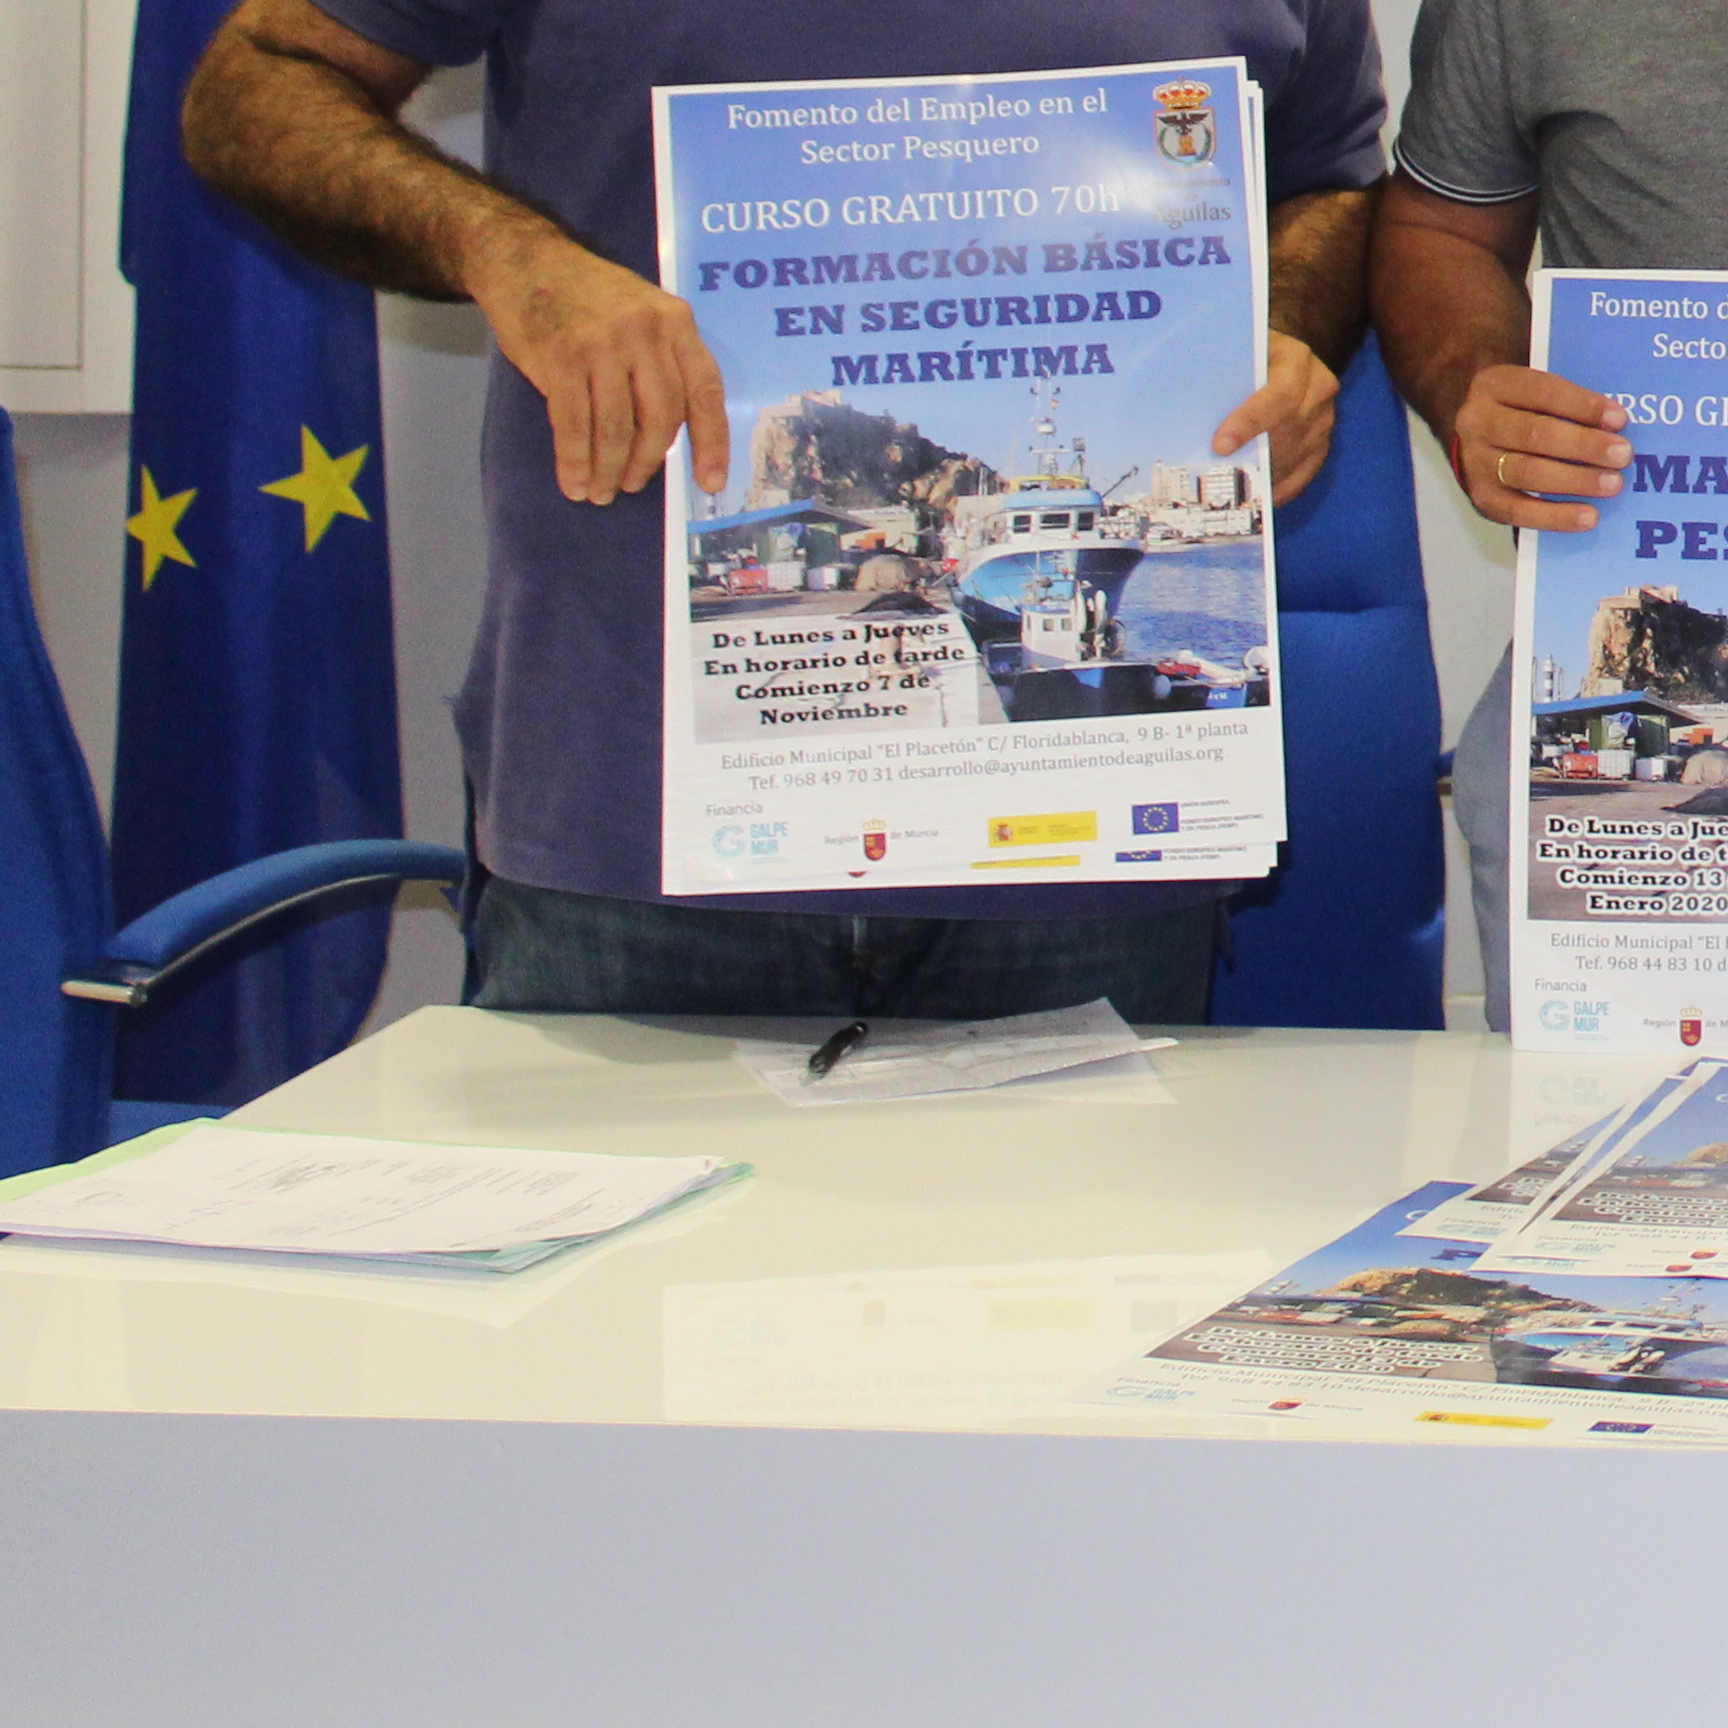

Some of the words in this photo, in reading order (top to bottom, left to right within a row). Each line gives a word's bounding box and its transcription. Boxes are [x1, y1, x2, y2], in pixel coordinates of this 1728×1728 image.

[728, 104, 858, 129] Fomento
[866, 97, 912, 124] del
[919, 94, 1032, 126] Empleo
[1038, 97, 1074, 116] en
[1082, 88, 1107, 113] el
[801, 139, 895, 164] Sector
[902, 135, 1040, 164] Pesquero
[701, 198, 831, 234] CURSO
[842, 188, 1038, 227] GRATUITO
[1051, 185, 1122, 219] 70h
[698, 240, 1028, 292] FORMACIÓN
[1044, 236, 1232, 273] BÁSICA
[774, 304, 845, 337] EN
[860, 290, 1162, 333] SEGURIDAD
[1590, 292, 1708, 319] Fomento
[831, 340, 1115, 387] MARÍTIMA
[713, 632, 746, 650] De
[733, 636, 746, 648] Lunes
[842, 630, 857, 644] a
[864, 617, 949, 644] Jueves
[704, 660, 737, 676] En
[744, 653, 846, 673] horario
[854, 650, 885, 666] de
[892, 644, 963, 663] tarde
[735, 675, 870, 700] Comienzo
[877, 675, 890, 690] 7
[899, 669, 931, 689] de
[760, 701, 907, 725] Noviembre
[1548, 819, 1579, 833] De
[1587, 819, 1662, 839] Lunes
[1670, 825, 1683, 835] a
[1540, 840, 1570, 858] En
[1577, 844, 1673, 861] horario
[1681, 845, 1711, 864] de
[1559, 869, 1688, 889] Comienzo
[1696, 870, 1723, 888] 13
[1588, 896, 1666, 914] Enero
[1672, 895, 1728, 913] 2020
